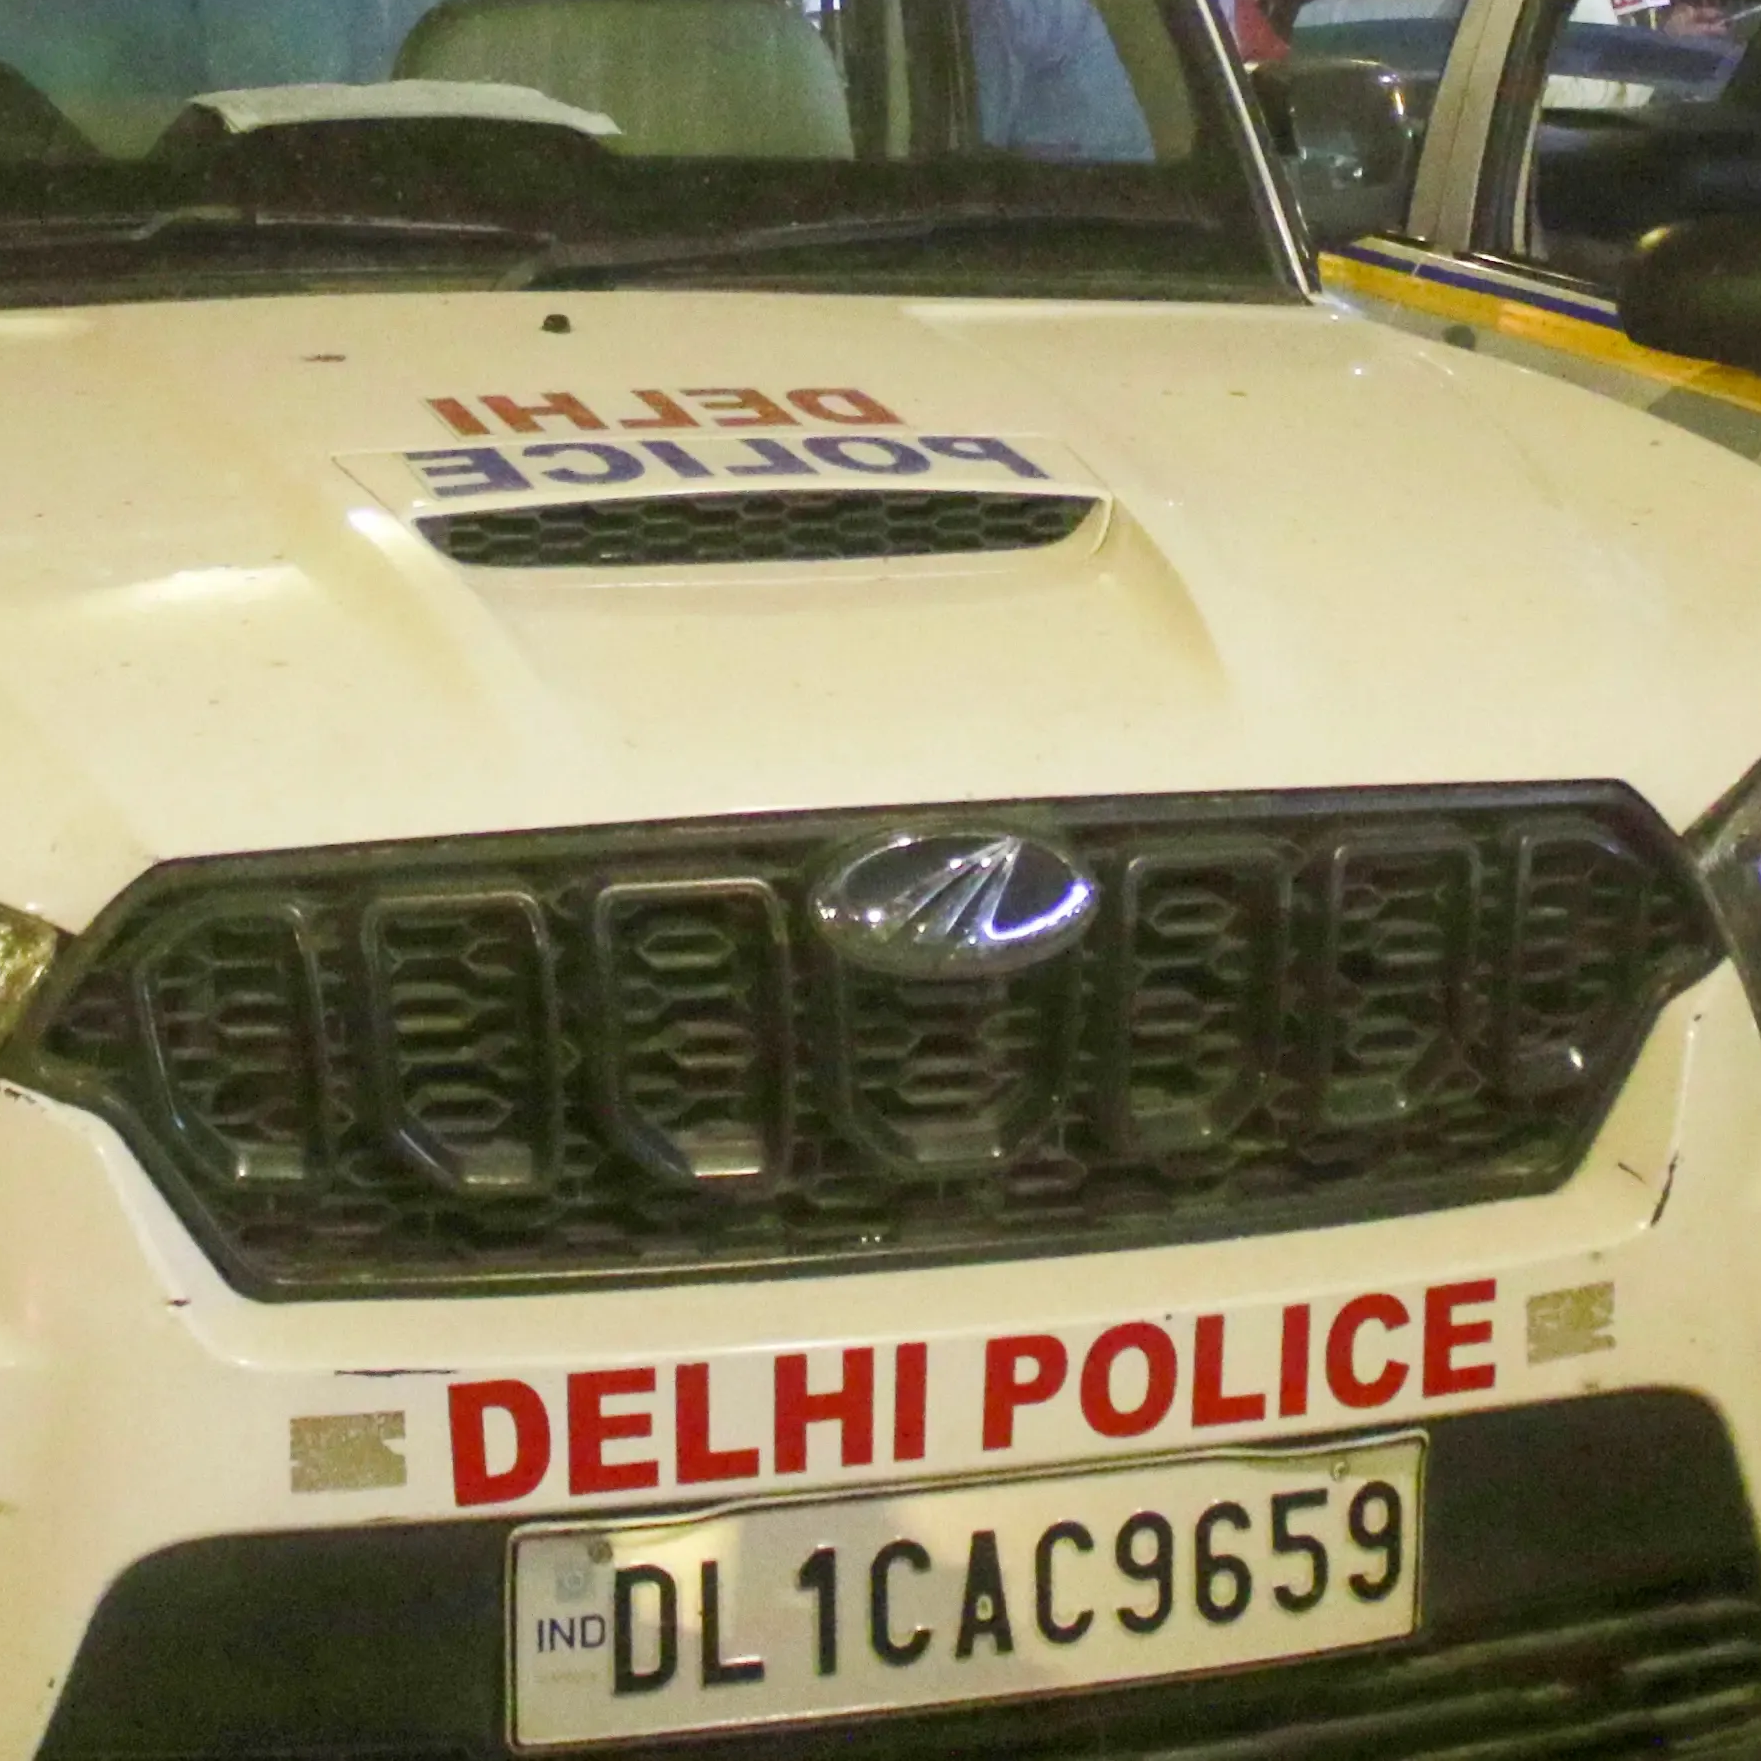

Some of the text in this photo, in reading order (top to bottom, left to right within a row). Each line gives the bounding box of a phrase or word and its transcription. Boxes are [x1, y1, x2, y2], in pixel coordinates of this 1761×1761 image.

[447, 1279, 1497, 1507] DELHI POLICE
[536, 1614, 607, 1653] IND
